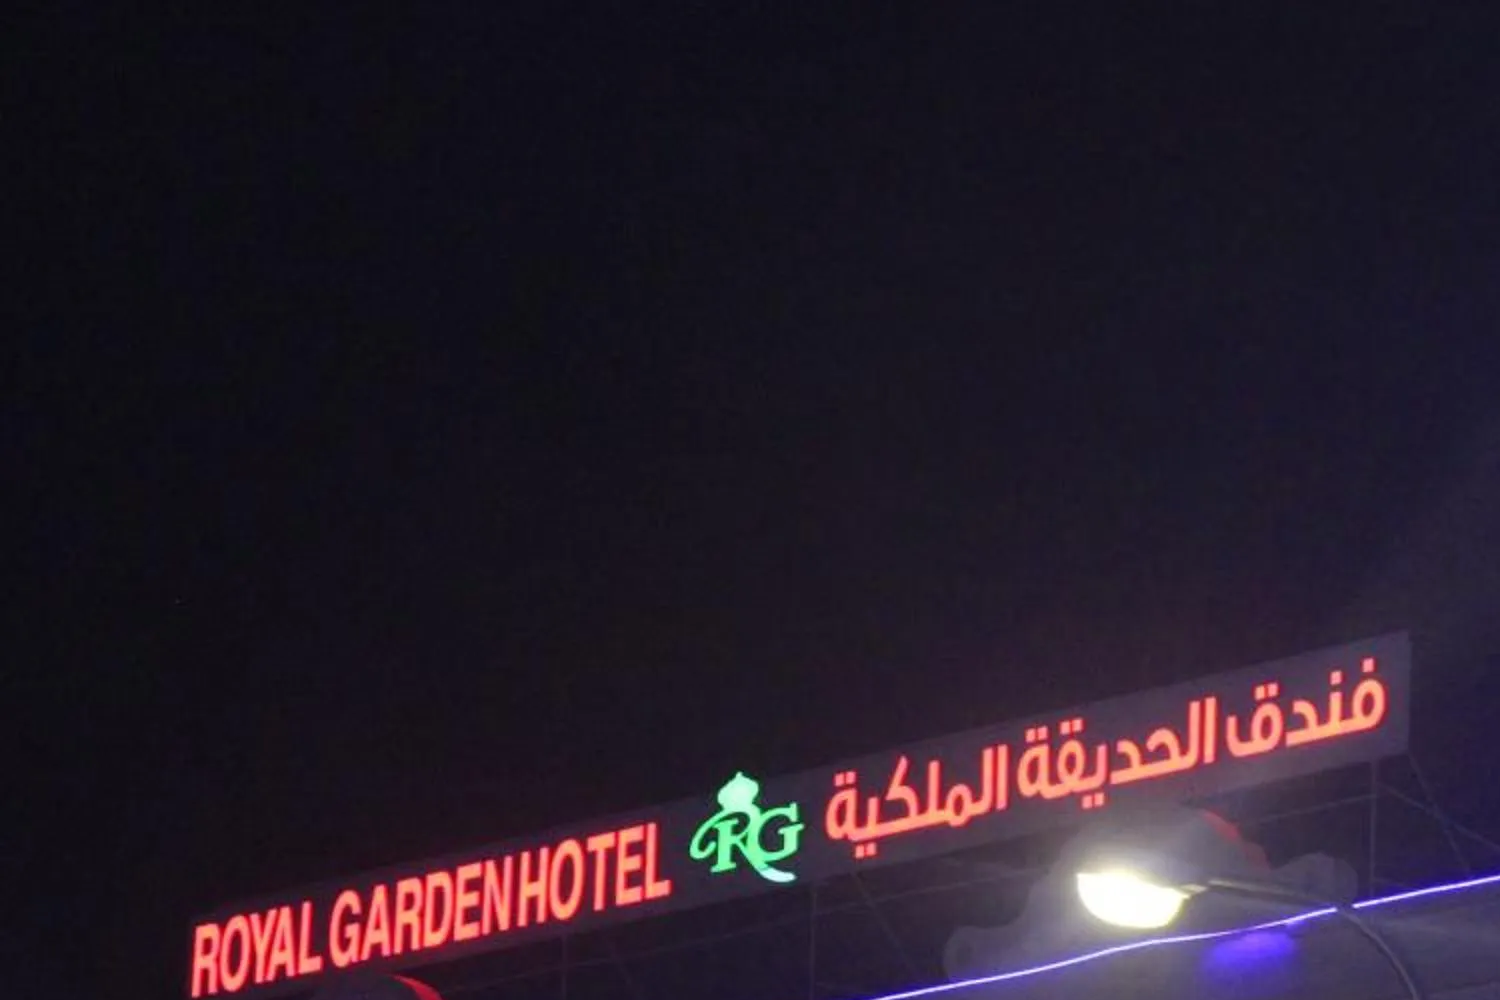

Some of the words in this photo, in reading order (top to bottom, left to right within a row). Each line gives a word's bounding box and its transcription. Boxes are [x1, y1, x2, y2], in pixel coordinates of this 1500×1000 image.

[1017, 695, 1217, 808] الحديقة
[1225, 657, 1388, 758] فندق
[824, 744, 1009, 858] الملكية
[191, 899, 323, 999] ROYAL
[328, 855, 512, 968] GARDEN
[515, 821, 672, 928] HOTEL
